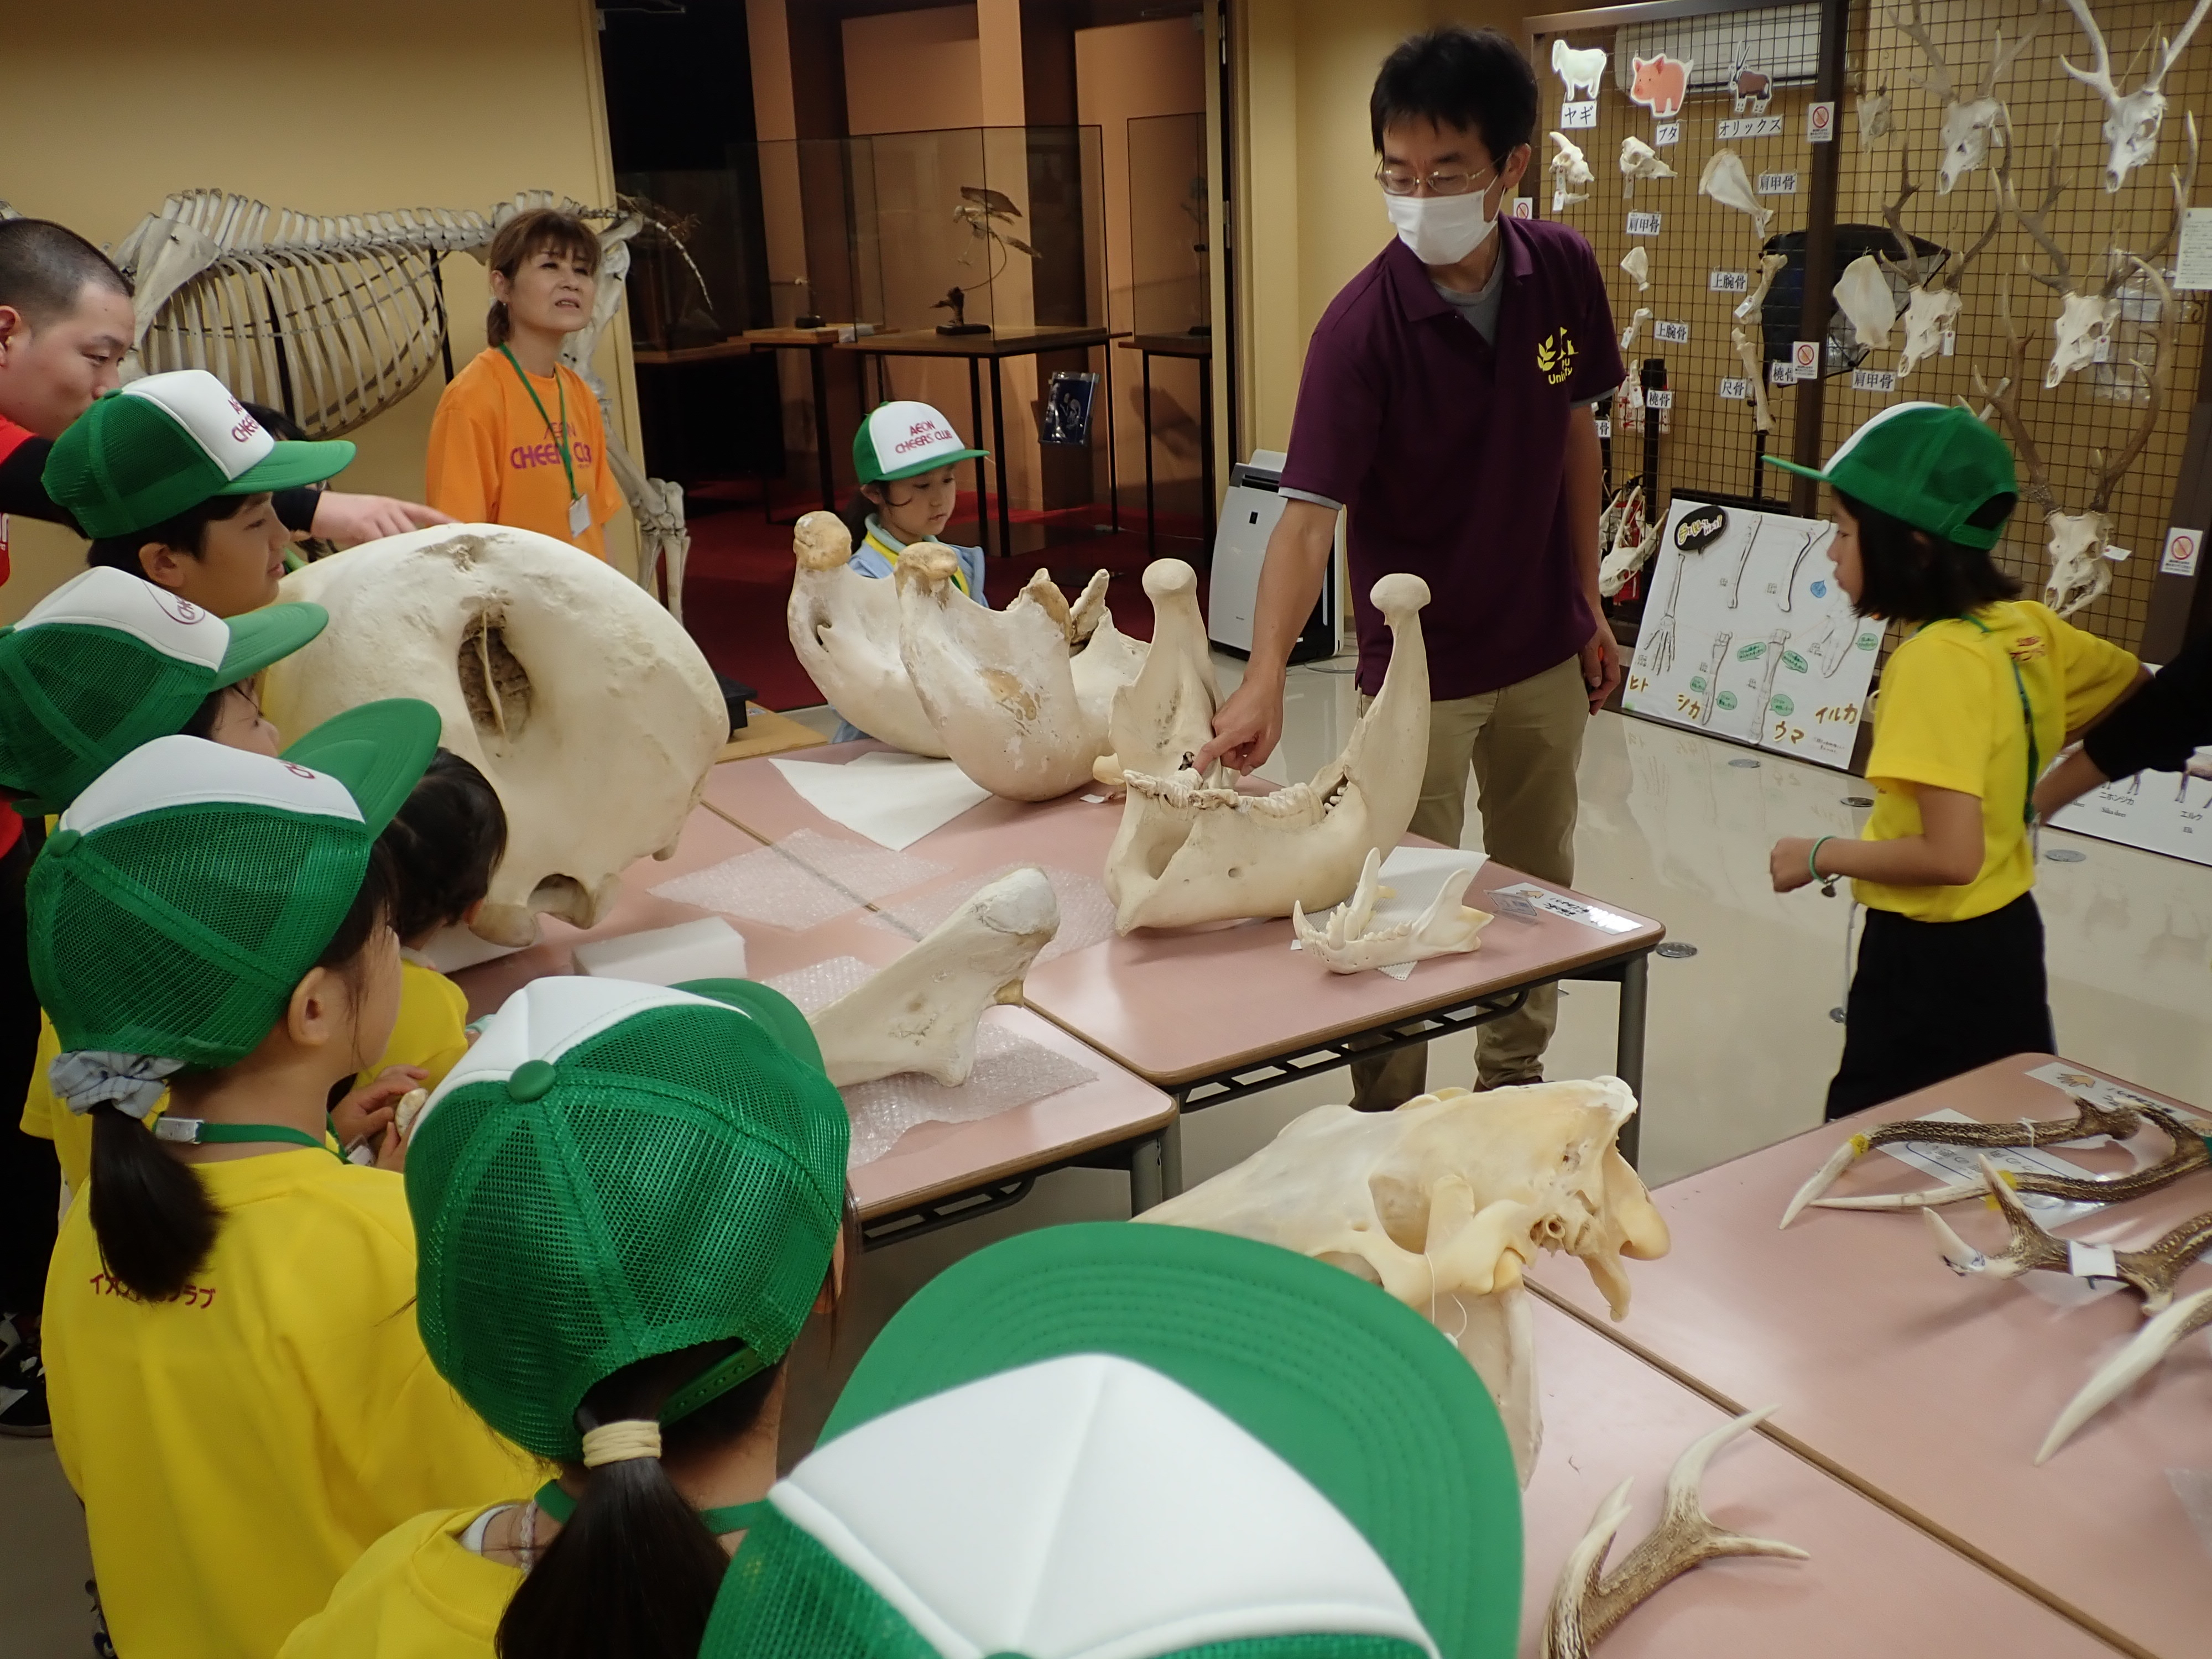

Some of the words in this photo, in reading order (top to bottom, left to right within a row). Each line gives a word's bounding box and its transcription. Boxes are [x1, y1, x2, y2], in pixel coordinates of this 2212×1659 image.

[1564, 105, 1594, 125] ヤギ
[1719, 118, 1781, 136] オリックス
[1760, 175, 1795, 190] 肩甲骨
[1713, 274, 1746, 289] 上腕骨
[1657, 323, 1687, 340] 上腕骨
[1548, 367, 1573, 385] Unity
[1854, 372, 1893, 389] 肩甲骨
[1721, 382, 1744, 395] 尺骨
[910, 420, 936, 436] AEON
[1595, 422, 1609, 436] 骨
[895, 433, 935, 453] CHEERS
[934, 430, 953, 440] CLUB
[1630, 675, 1648, 692] ヒト
[1678, 695, 1700, 719] シカ
[1815, 703, 1858, 724] イルカ
[1775, 721, 1804, 744] ウマ
[2099, 791, 2135, 806] ニホンジカ
[2180, 811, 2203, 821] エルク
